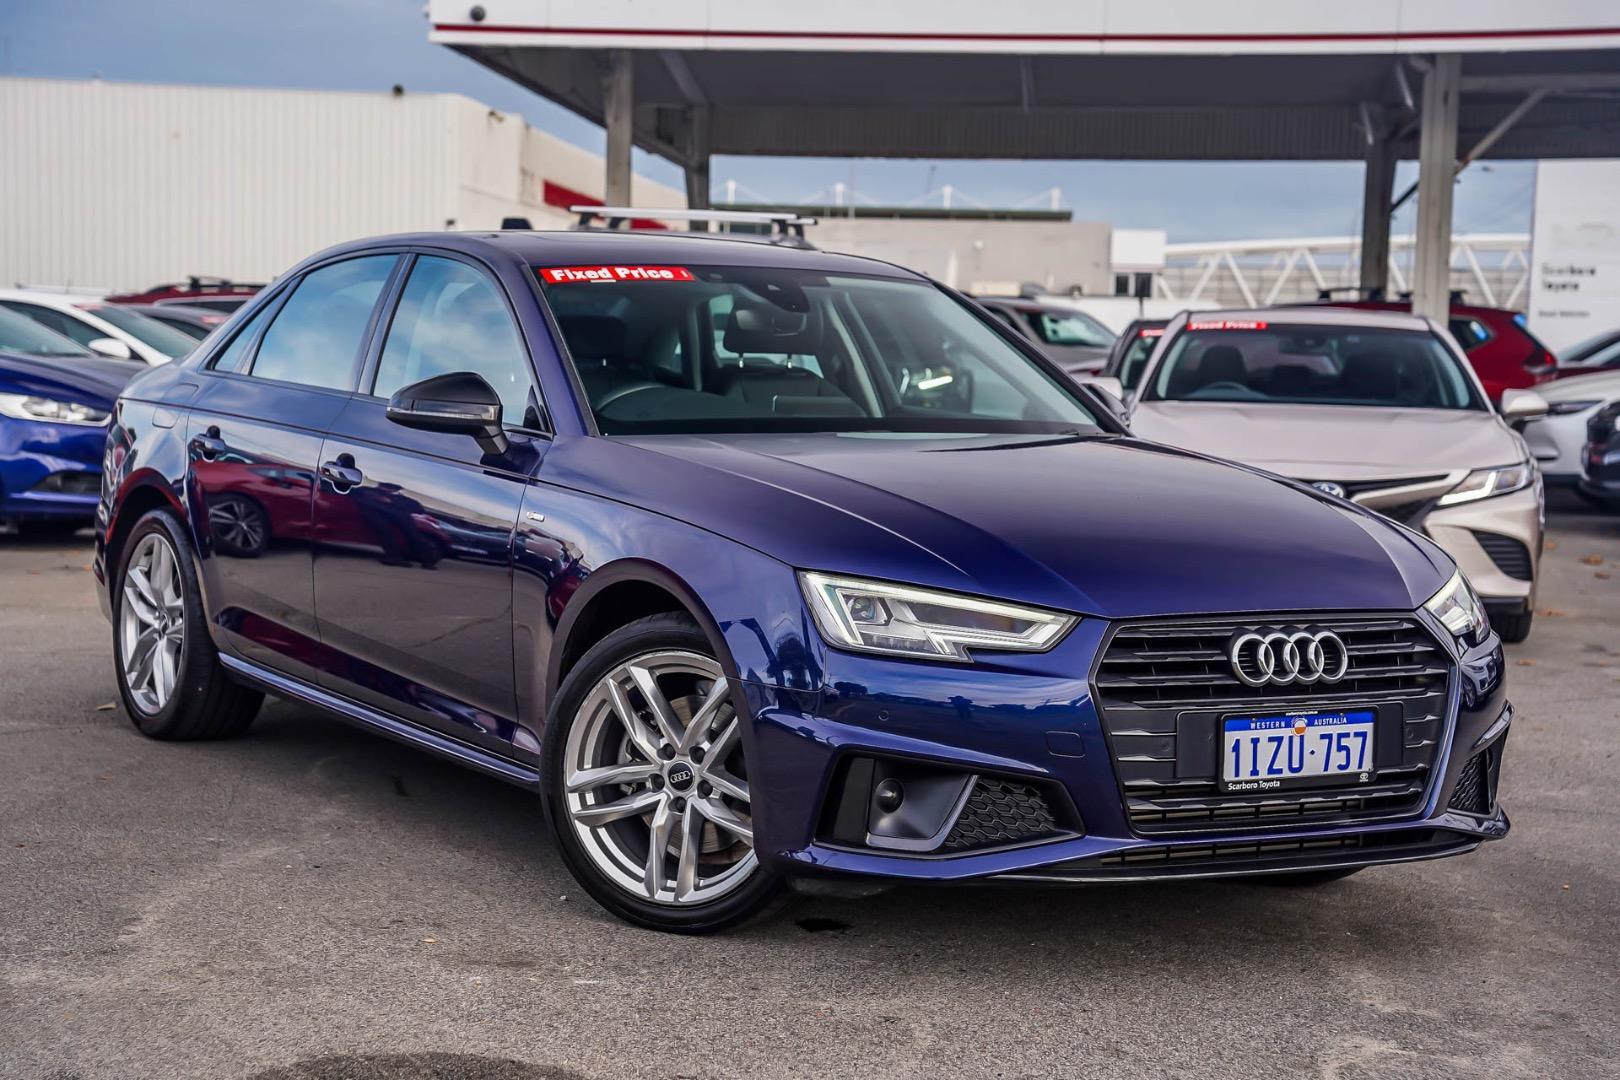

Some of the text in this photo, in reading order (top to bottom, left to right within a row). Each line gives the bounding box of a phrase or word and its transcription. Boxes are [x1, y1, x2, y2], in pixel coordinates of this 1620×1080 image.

[550, 267, 674, 281] Fixed Price
[1250, 717, 1347, 730] WESTERN AUSTRALIA
[1228, 780, 1280, 791] Scarboro Toyota
